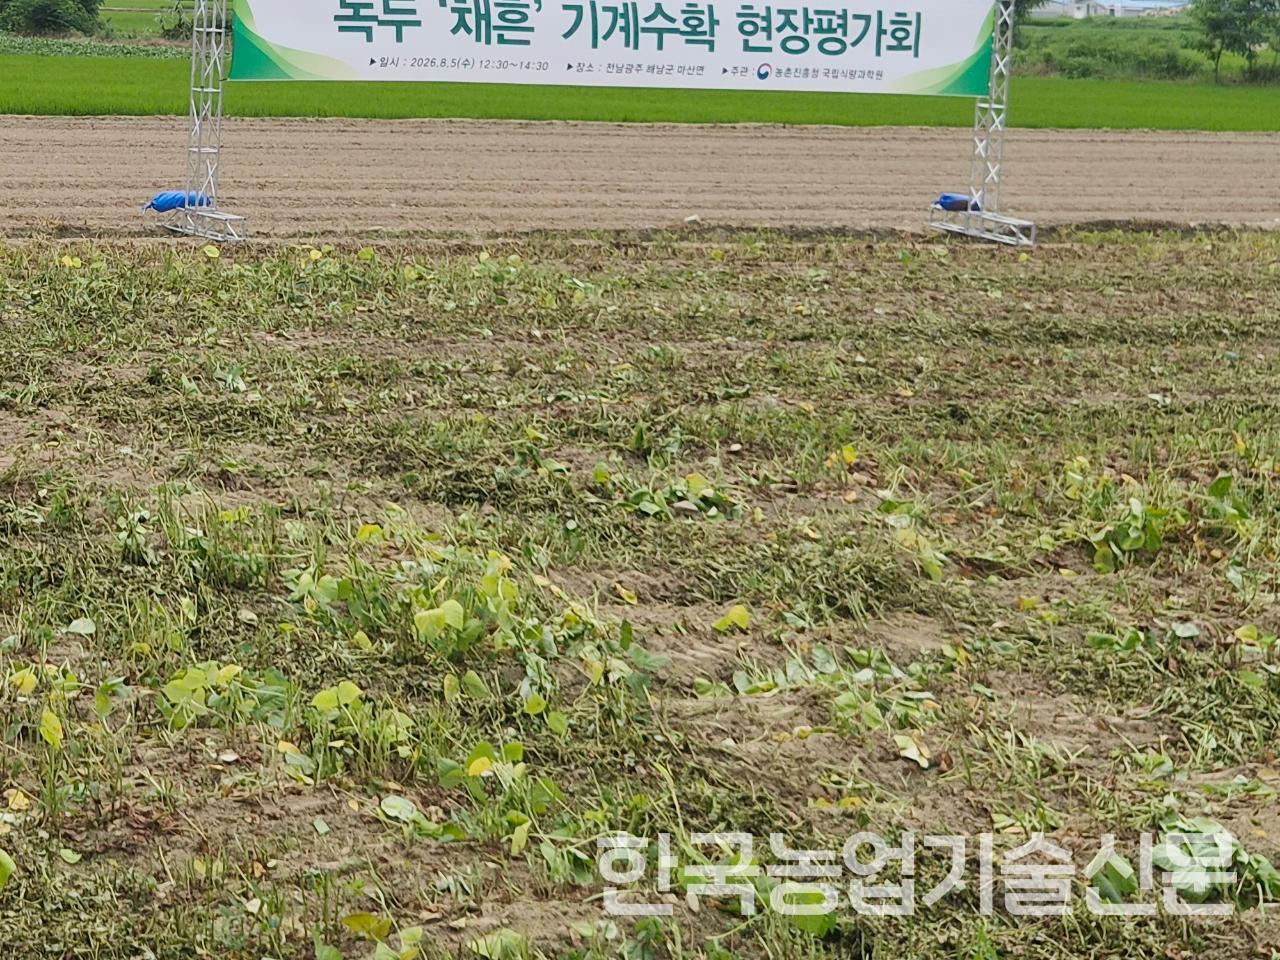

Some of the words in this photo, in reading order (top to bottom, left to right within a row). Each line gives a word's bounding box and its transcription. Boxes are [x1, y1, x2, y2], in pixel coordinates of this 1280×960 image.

[561, 0, 720, 53] 기계수확
[735, 3, 922, 58] 현장평가회
[479, 59, 549, 71] 12:30~14:30
